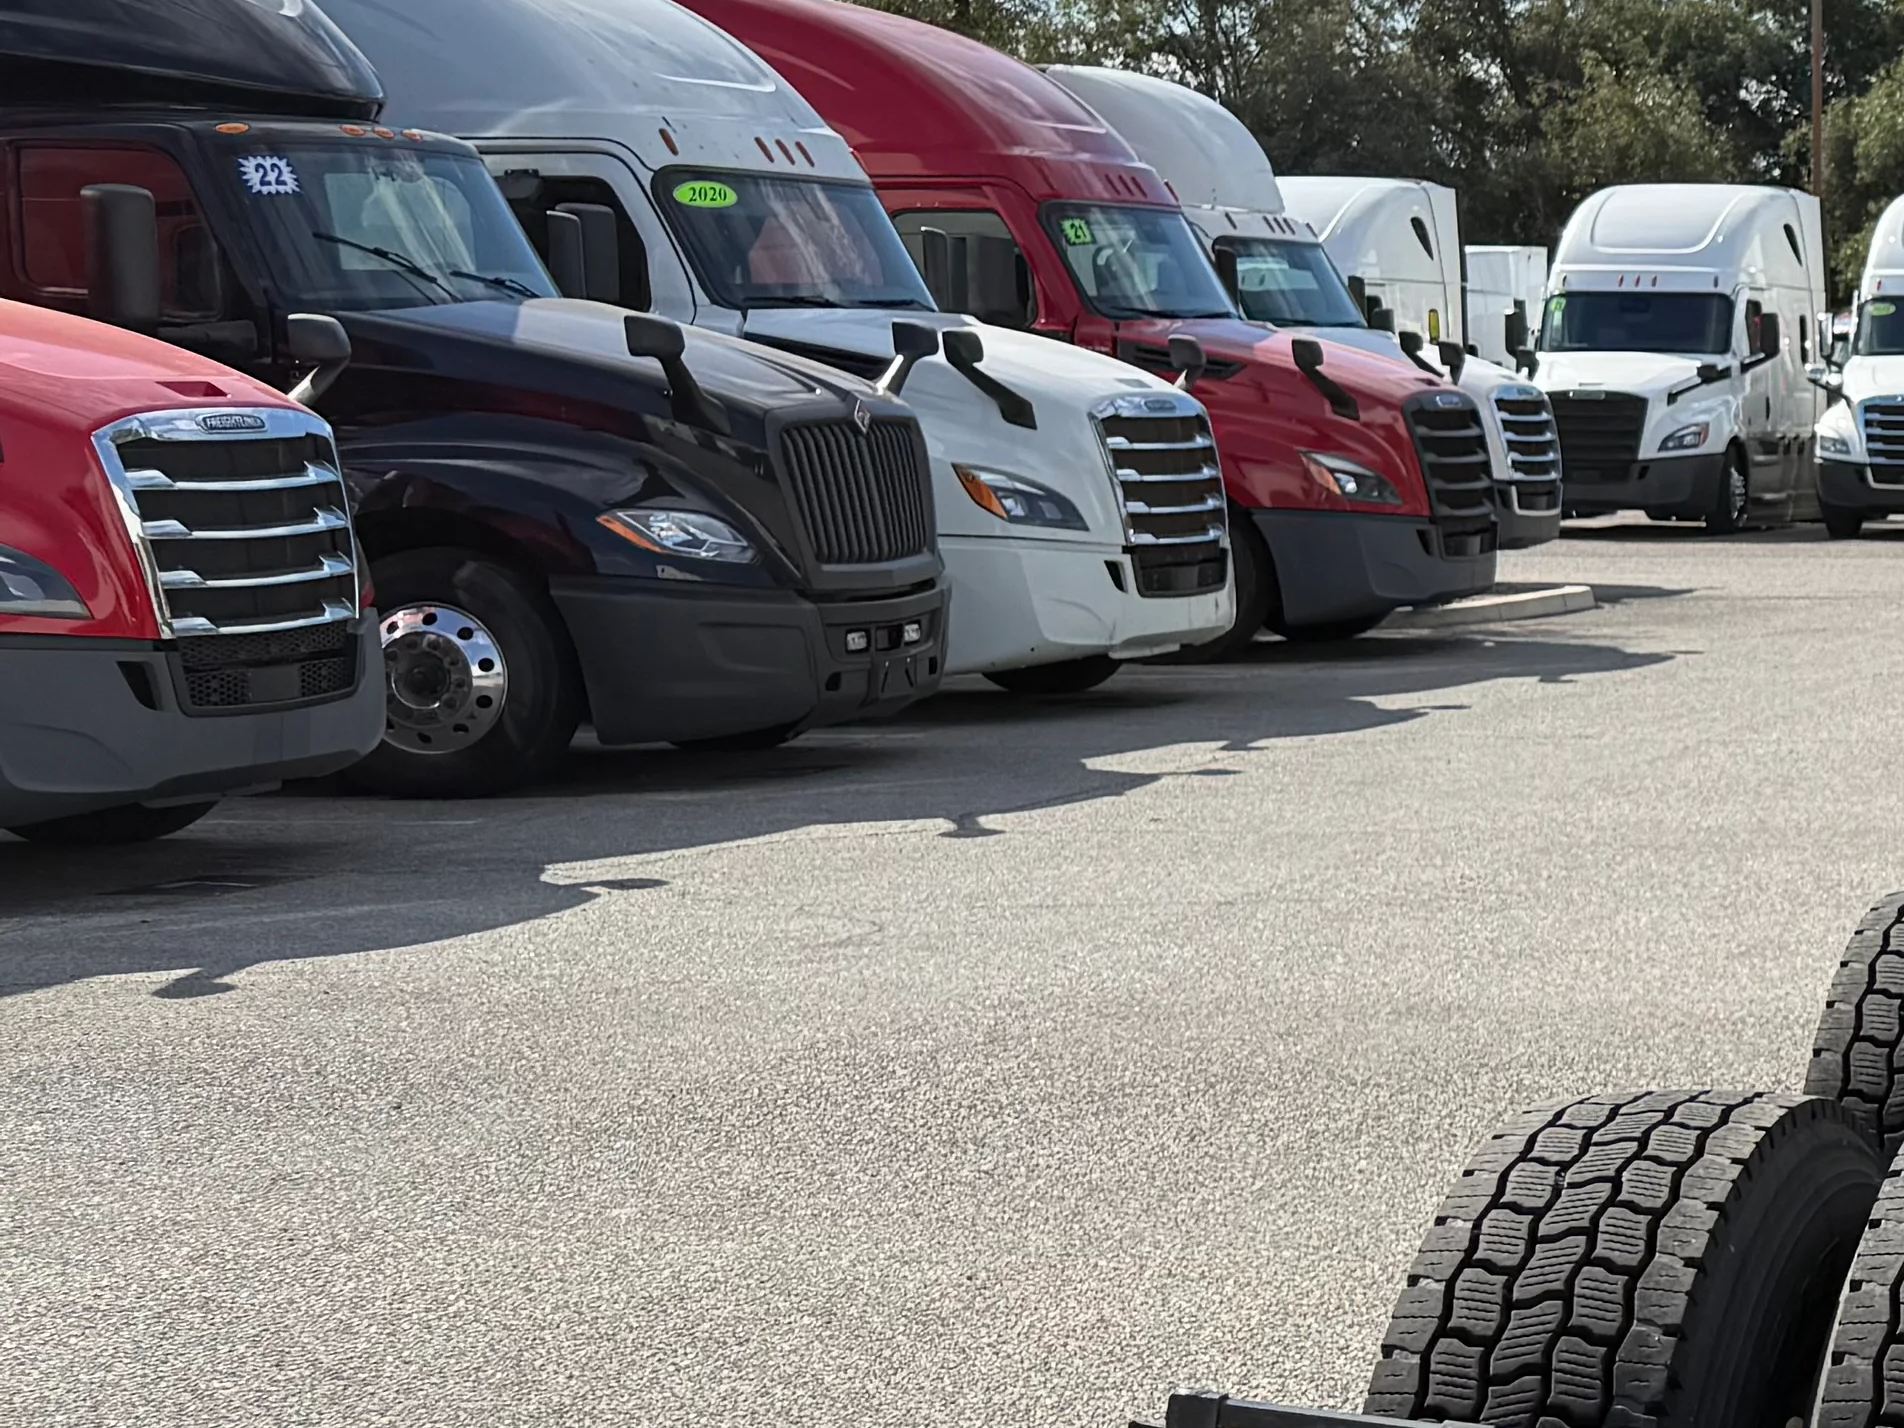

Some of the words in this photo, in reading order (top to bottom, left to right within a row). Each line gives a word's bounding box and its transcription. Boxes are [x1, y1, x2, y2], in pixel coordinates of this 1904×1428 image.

[254, 162, 288, 187] 22
[688, 186, 727, 202] 2020
[1069, 222, 1087, 240] 21
